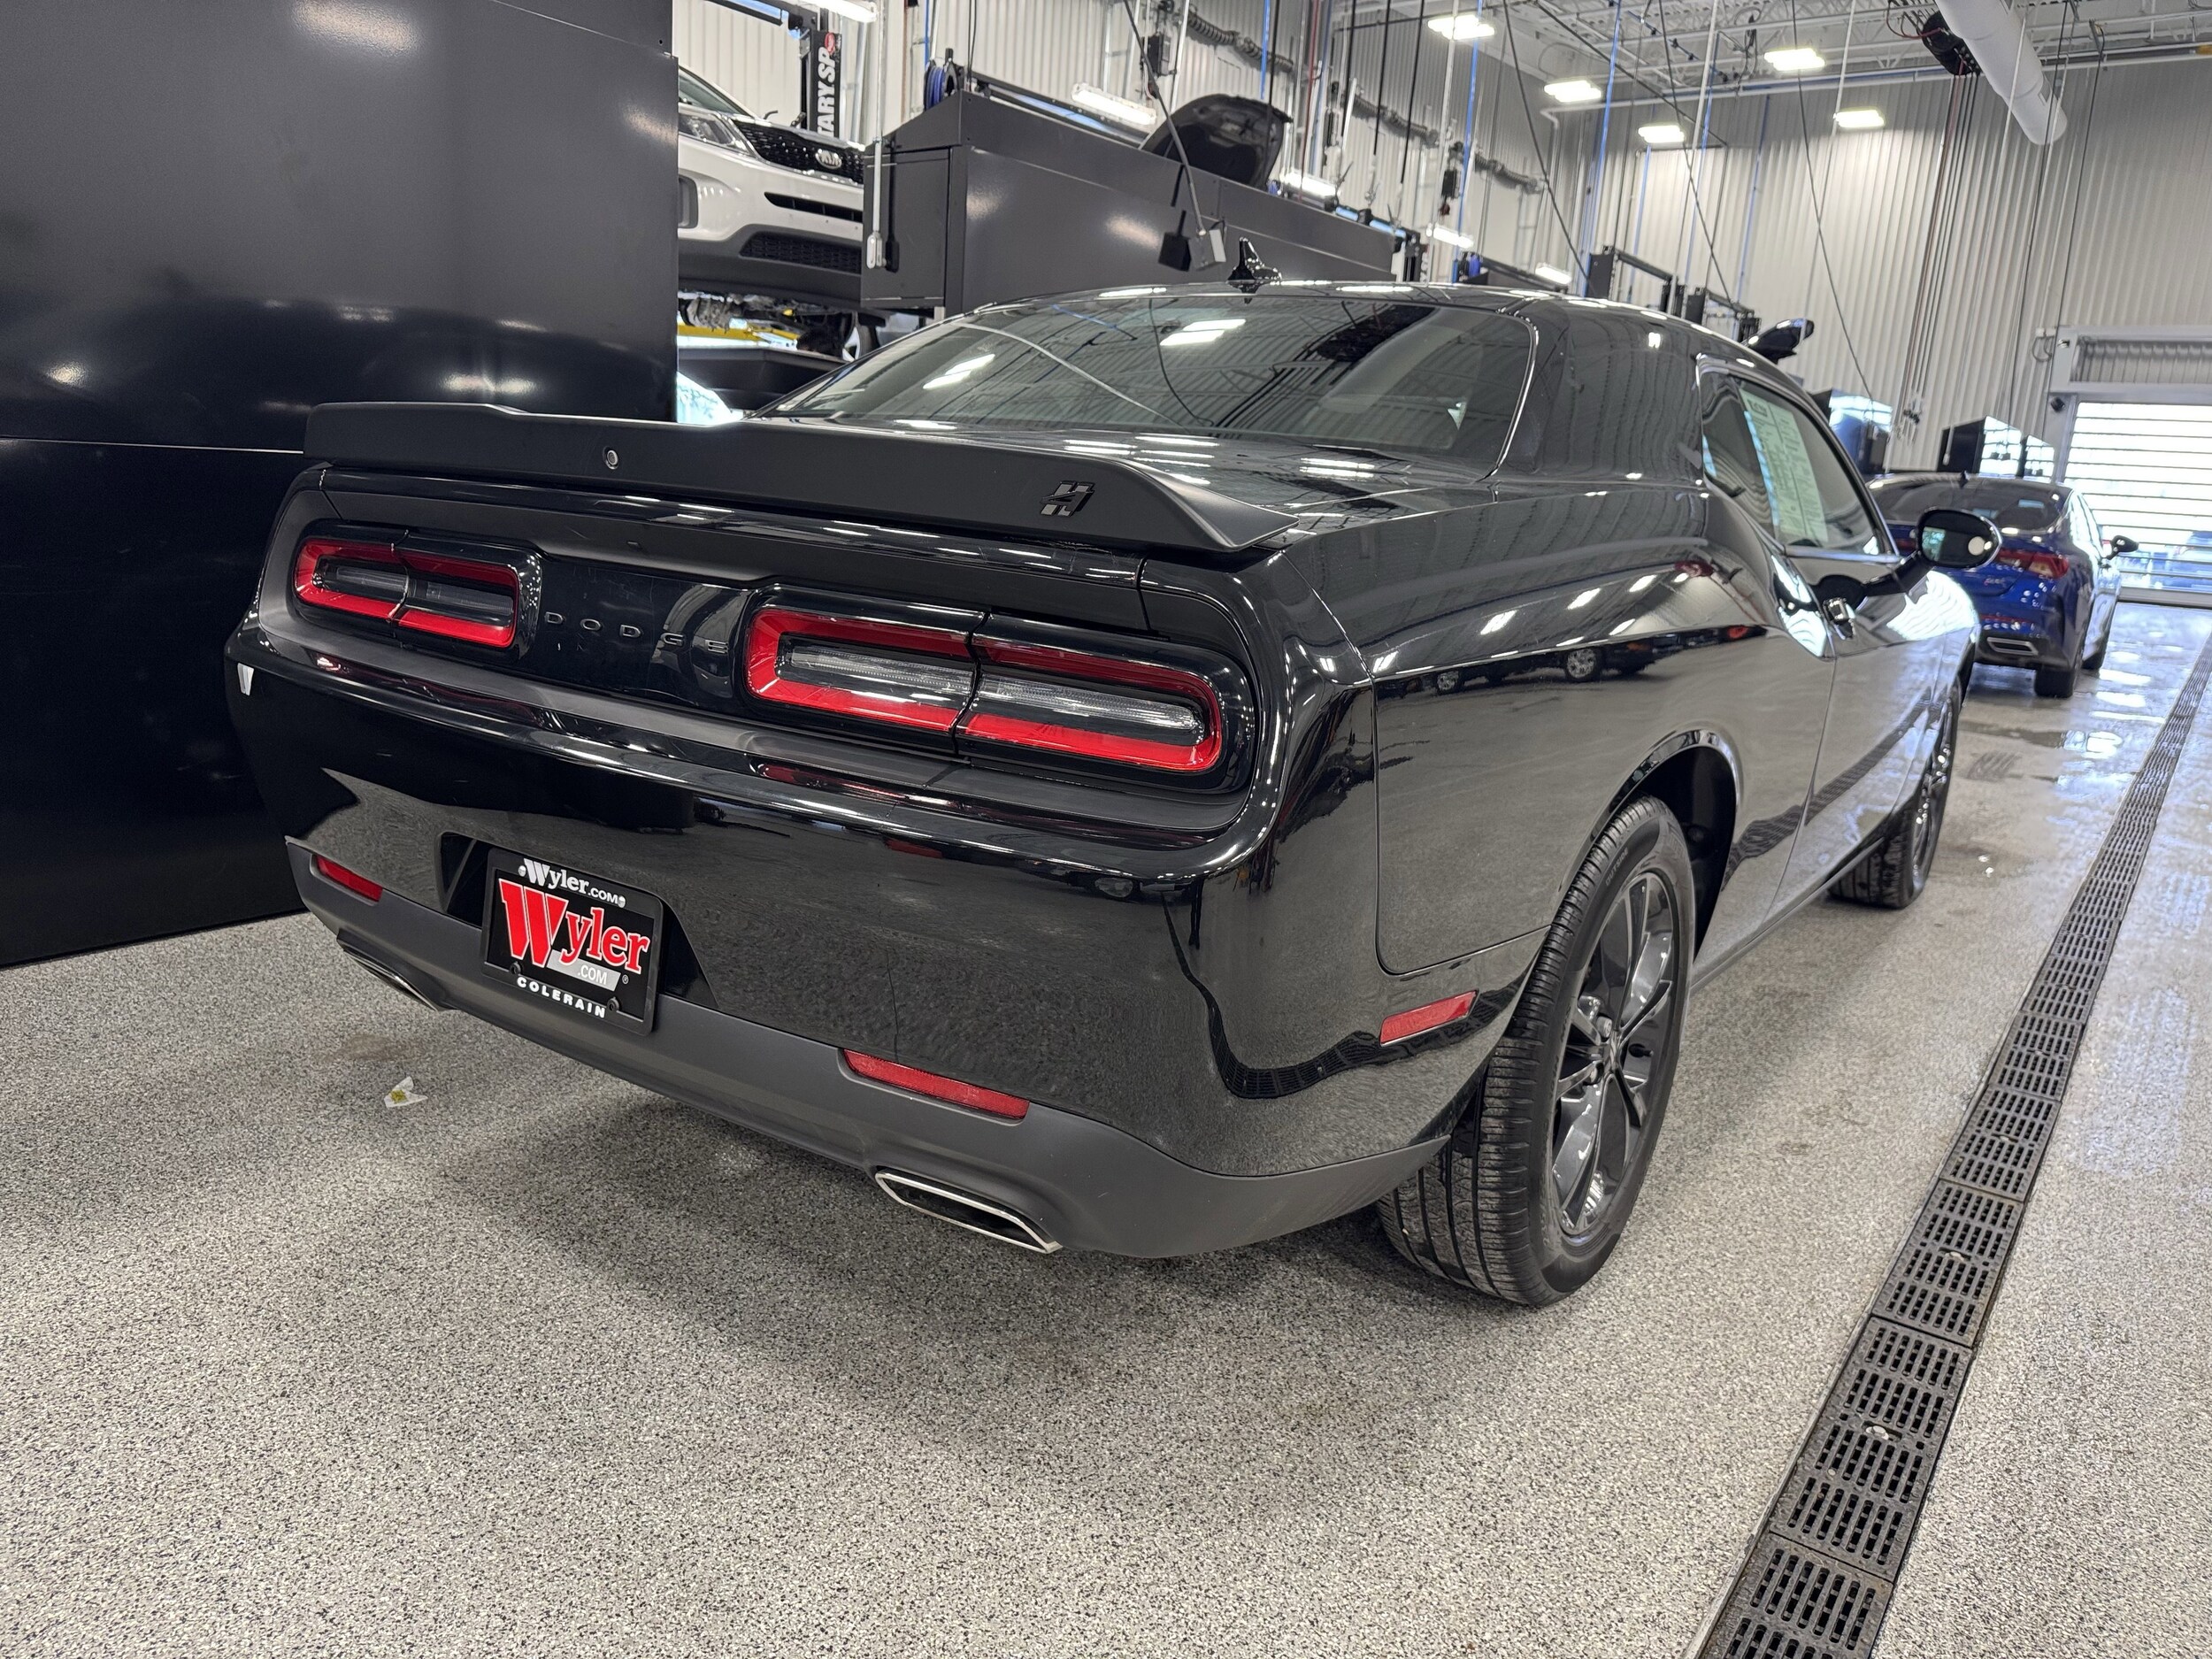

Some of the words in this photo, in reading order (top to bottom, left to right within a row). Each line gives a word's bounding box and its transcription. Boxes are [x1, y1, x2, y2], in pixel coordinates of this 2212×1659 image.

[544, 611, 729, 654] DODGE
[498, 878, 650, 974] Wyler
[516, 976, 606, 1018] COLERAIN
